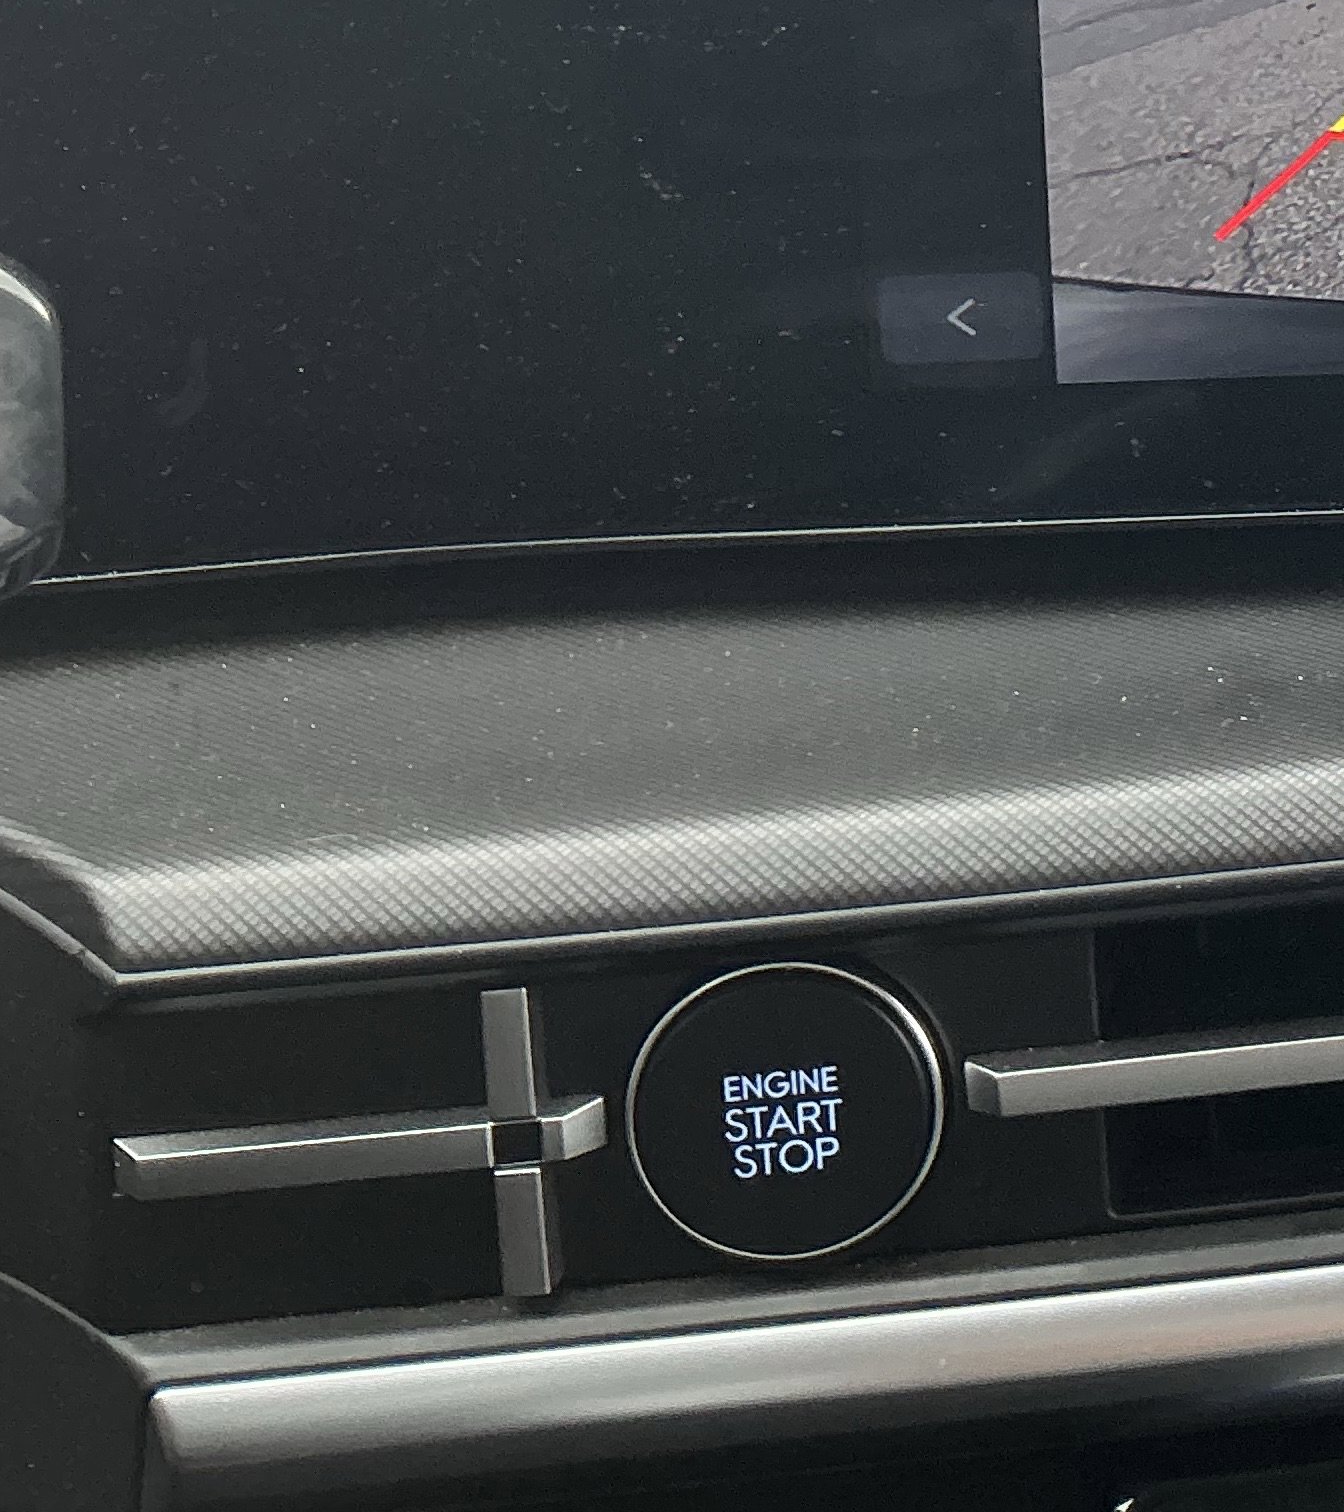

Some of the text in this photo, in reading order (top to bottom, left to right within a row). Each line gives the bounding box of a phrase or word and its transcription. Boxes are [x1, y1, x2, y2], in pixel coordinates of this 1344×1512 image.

[722, 1064, 840, 1104] ENGINE
[723, 1097, 844, 1144] START
[732, 1135, 841, 1180] STOP
